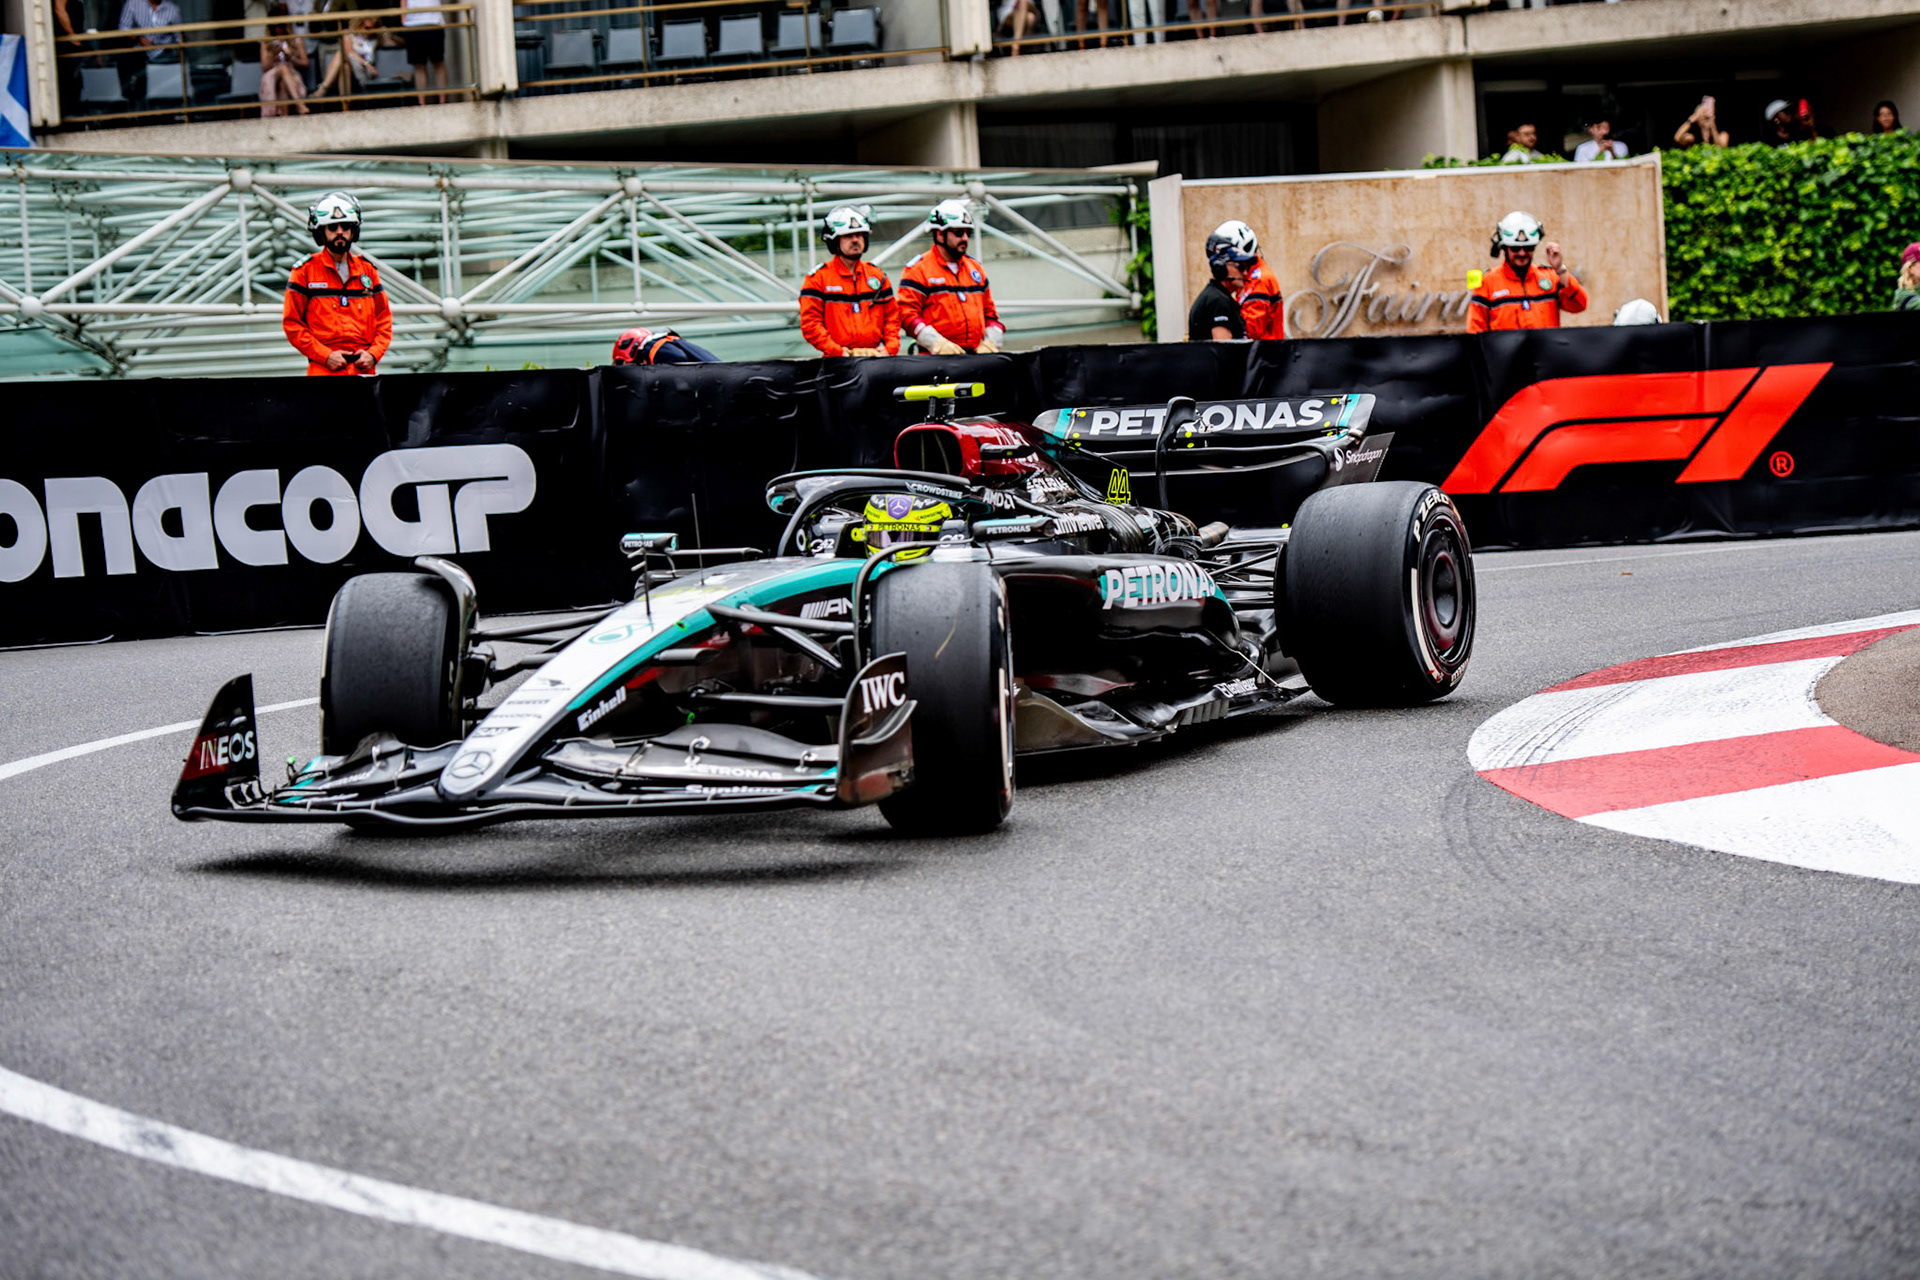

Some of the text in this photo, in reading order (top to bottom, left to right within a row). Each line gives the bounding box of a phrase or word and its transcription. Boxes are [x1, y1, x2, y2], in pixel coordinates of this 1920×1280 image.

[1345, 449, 1383, 465] Snapdragon
[911, 482, 963, 500] CROWDSTRIKE
[982, 490, 1005, 508] AMD
[1107, 468, 1132, 505] 44
[877, 523, 921, 532] PETRONAS
[986, 525, 1032, 535] PETRONAS
[1102, 562, 1216, 610] PETRONAS
[859, 671, 907, 714] IWC
[576, 685, 628, 732] Einhell
[199, 730, 255, 770] INEOS
